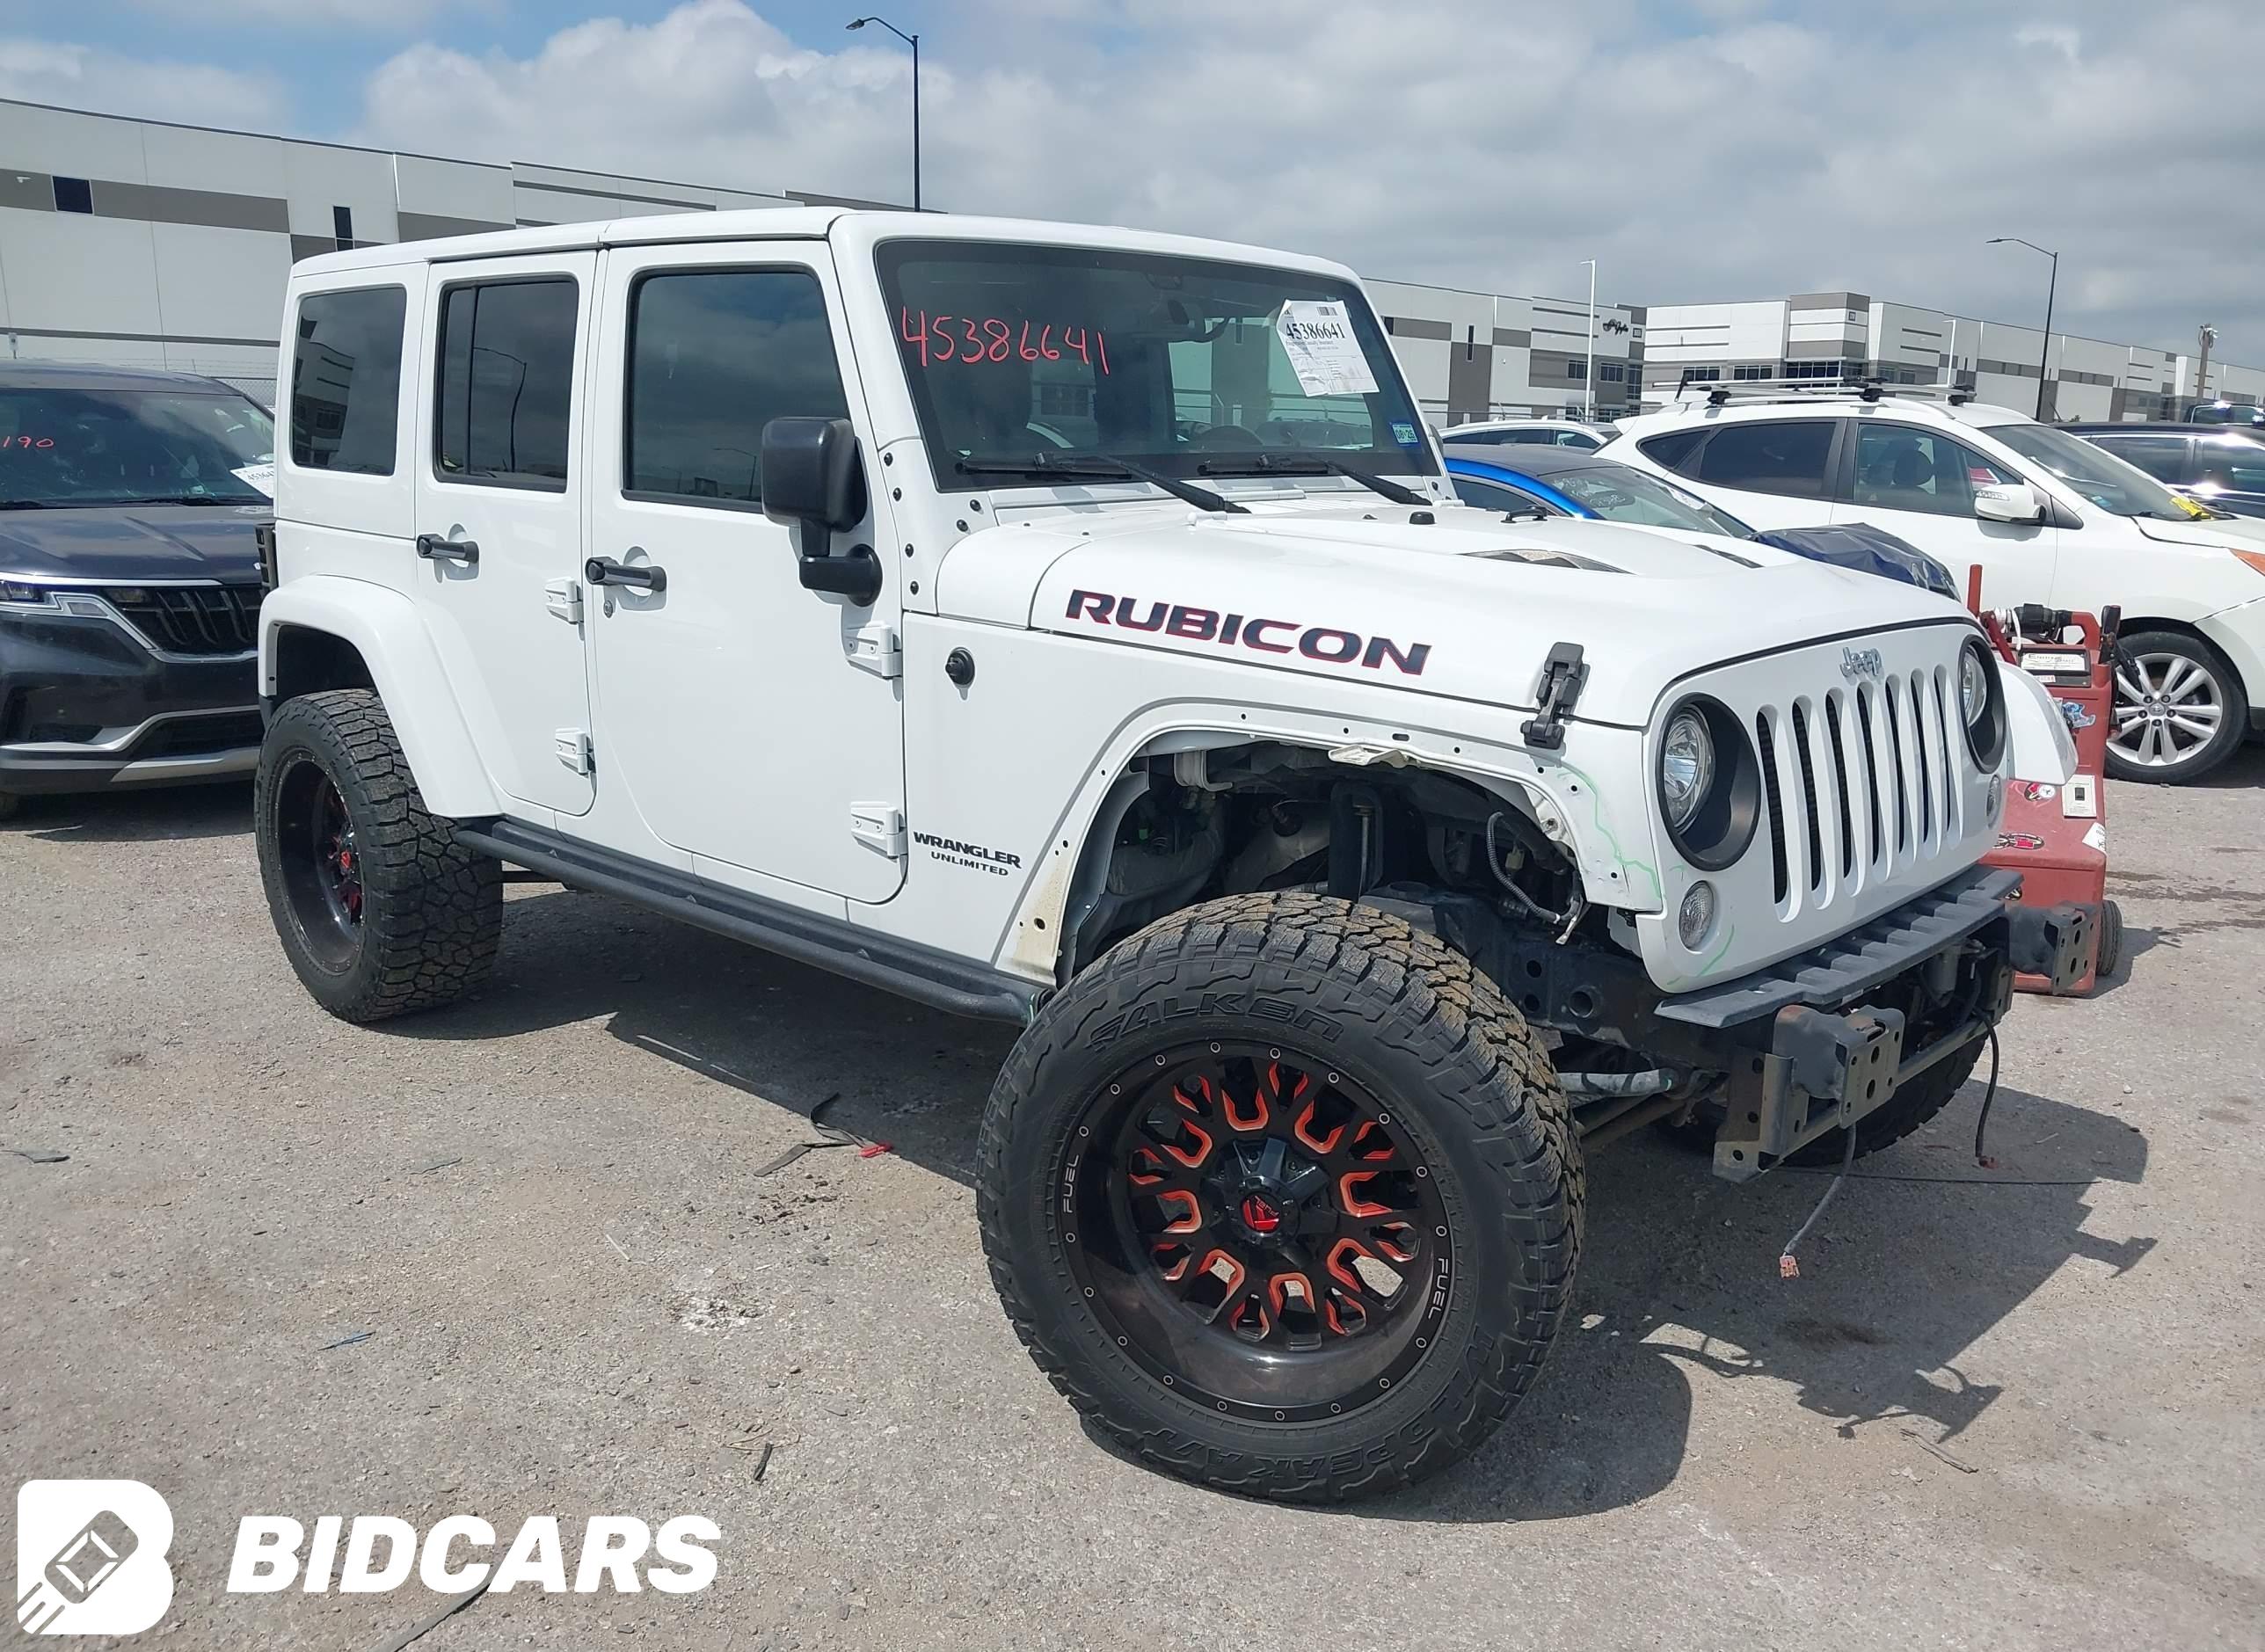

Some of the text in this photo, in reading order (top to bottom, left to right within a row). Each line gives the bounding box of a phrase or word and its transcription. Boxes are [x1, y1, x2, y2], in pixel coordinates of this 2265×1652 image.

[901, 306, 1110, 375] 45386641
[1285, 322, 1345, 340] 45386641
[1065, 588, 1432, 676] RUBICON
[1839, 646, 1883, 677] Jeep
[913, 831, 1022, 869] WRANGLER
[930, 851, 1009, 877] UNLIMITED
[1084, 991, 1345, 1052] FALKEN
[1062, 1153, 1080, 1213] FUEL
[1427, 1257, 1450, 1320] FUEL
